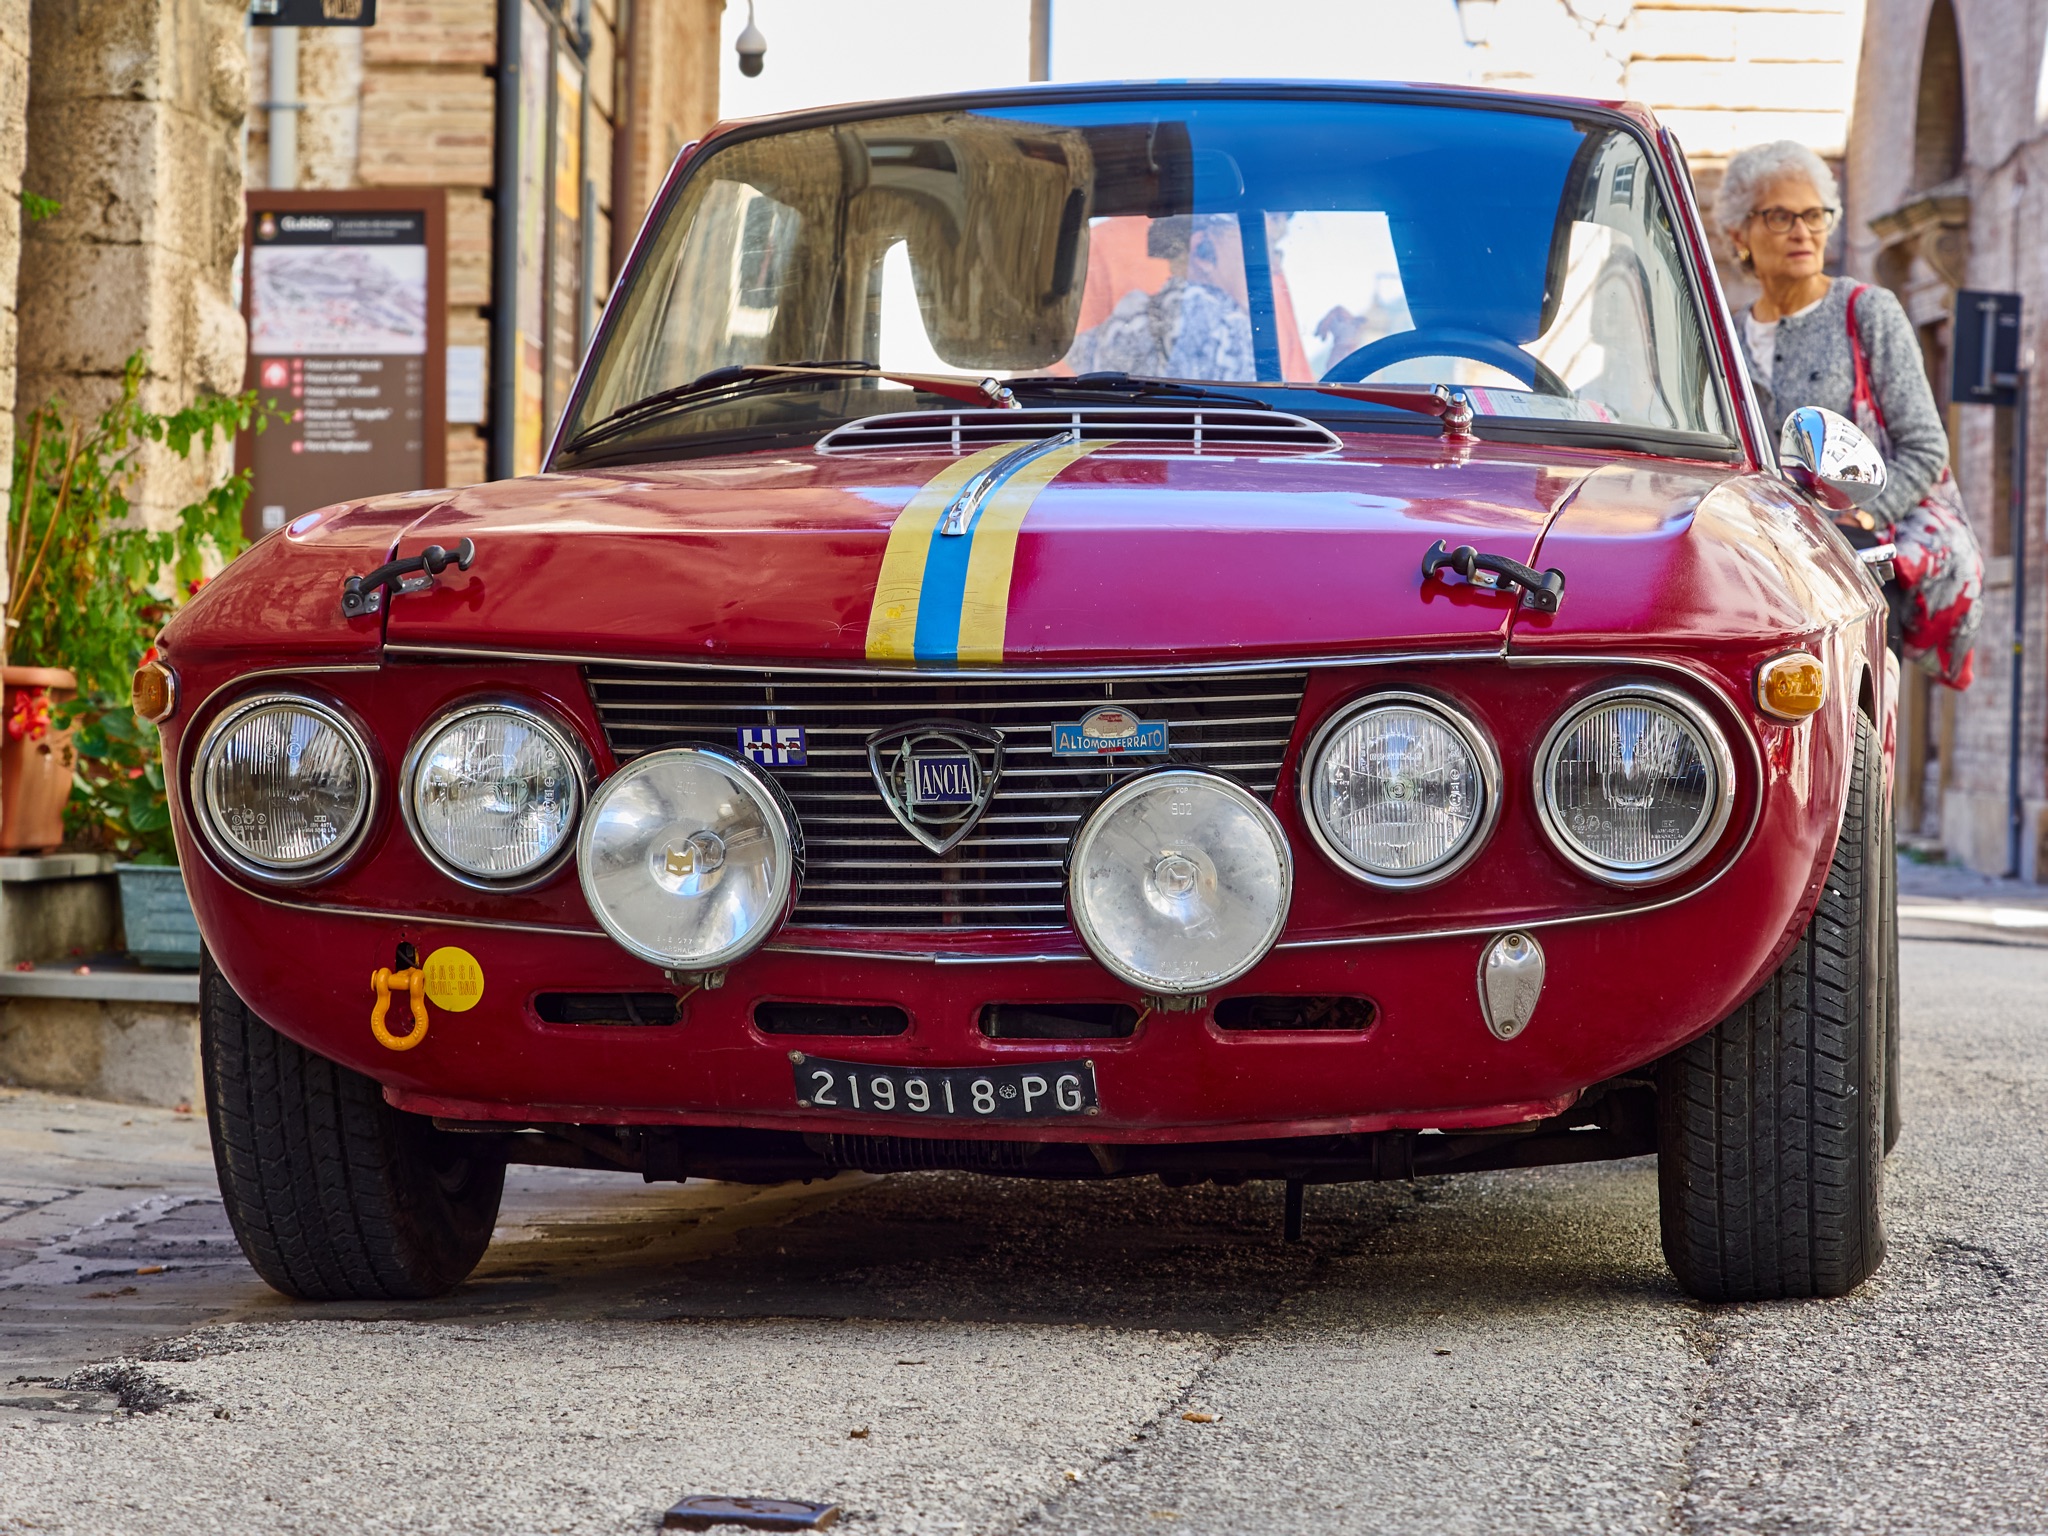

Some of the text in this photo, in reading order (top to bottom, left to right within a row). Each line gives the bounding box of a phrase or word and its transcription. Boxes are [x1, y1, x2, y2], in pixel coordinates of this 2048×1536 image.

[282, 217, 332, 231] Gubbio
[742, 728, 801, 764] HF
[1059, 729, 1163, 749] ALTOMONFERRATO
[914, 759, 971, 801] LANCIA
[429, 965, 476, 980] SASSA
[811, 1070, 1082, 1115] 219918 PG
